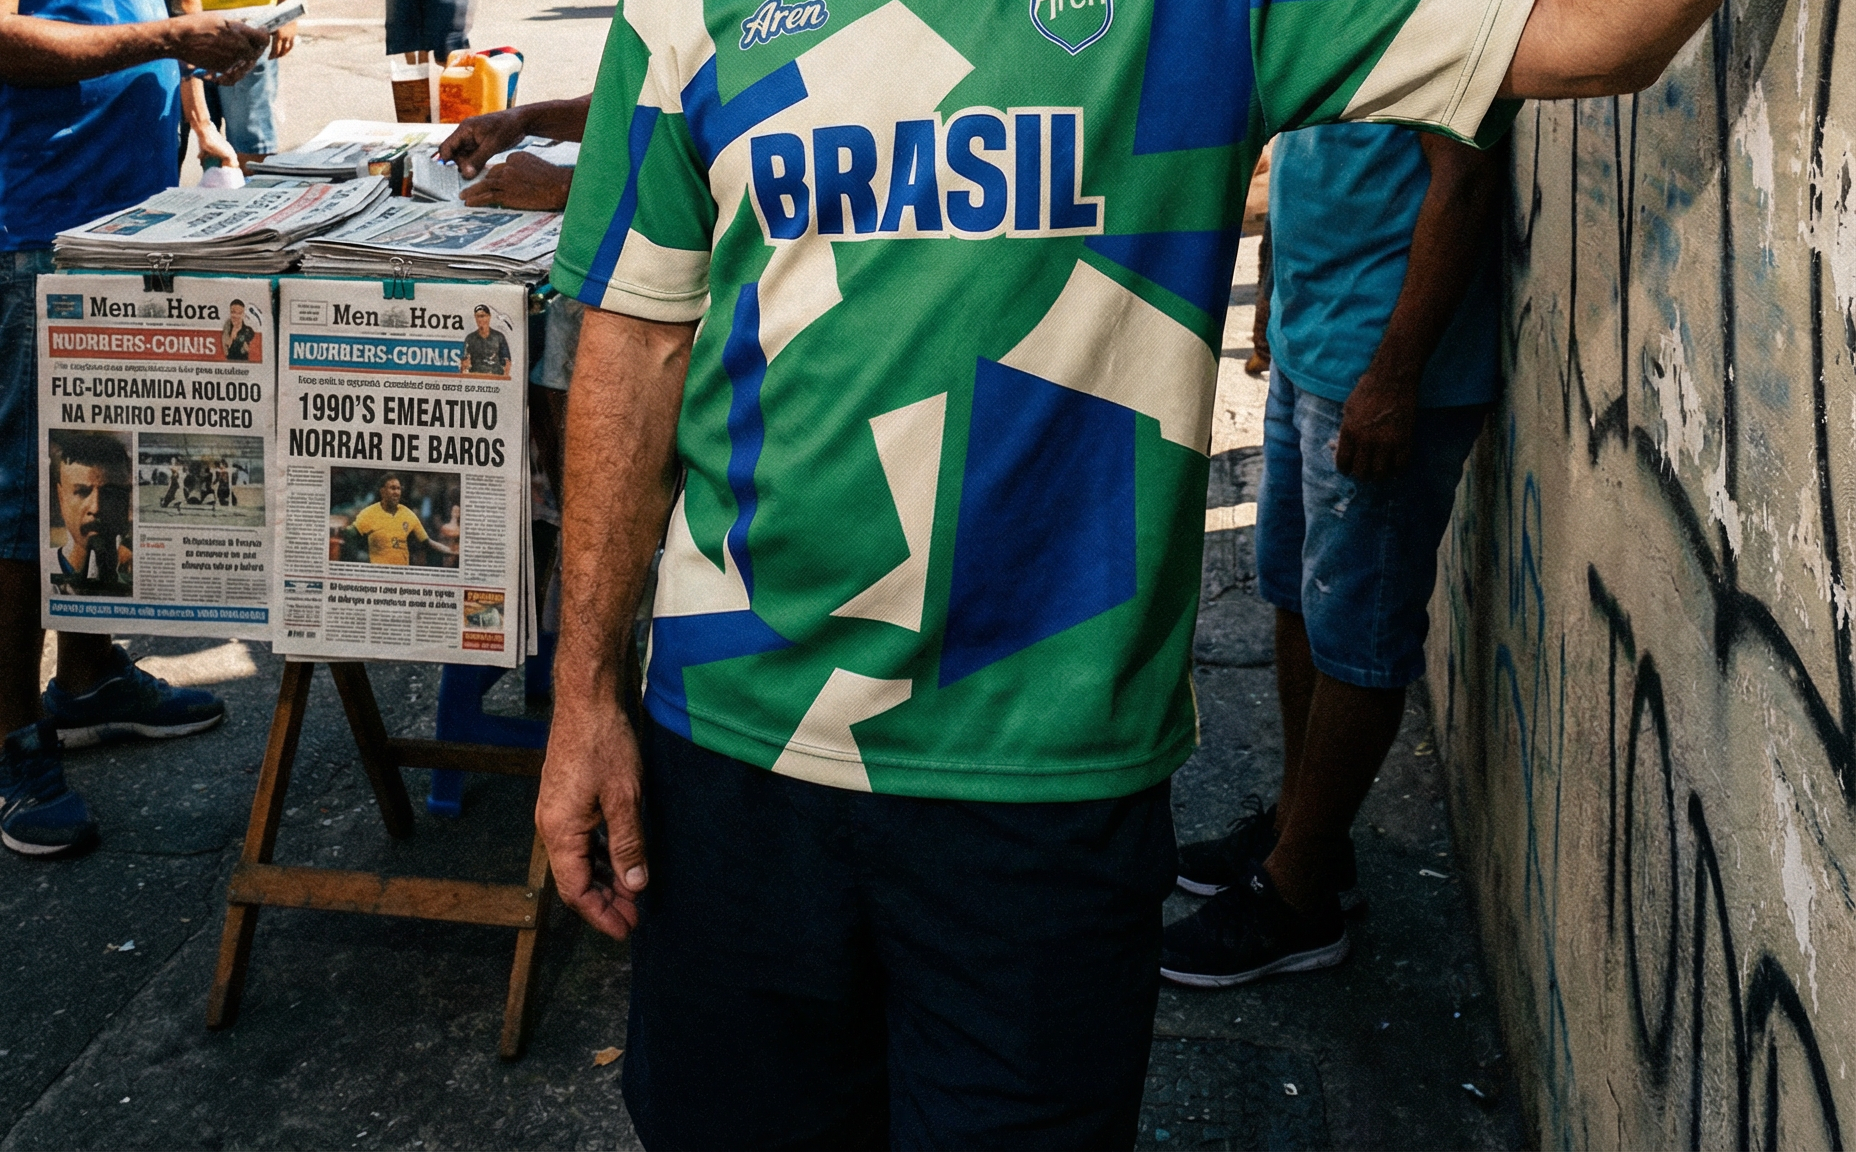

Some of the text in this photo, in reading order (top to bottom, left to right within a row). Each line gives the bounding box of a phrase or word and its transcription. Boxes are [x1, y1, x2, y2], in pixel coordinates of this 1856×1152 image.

[750, 111, 1100, 241] BRASIL
[90, 296, 137, 318] Men
[167, 298, 221, 321] Hora
[332, 304, 379, 327] Men
[409, 307, 465, 331] Hora
[61, 403, 86, 424] NA
[91, 404, 155, 426] PARIRO
[383, 396, 498, 431] EMEATIVO
[289, 427, 506, 468] NORRAR DE BAROS
